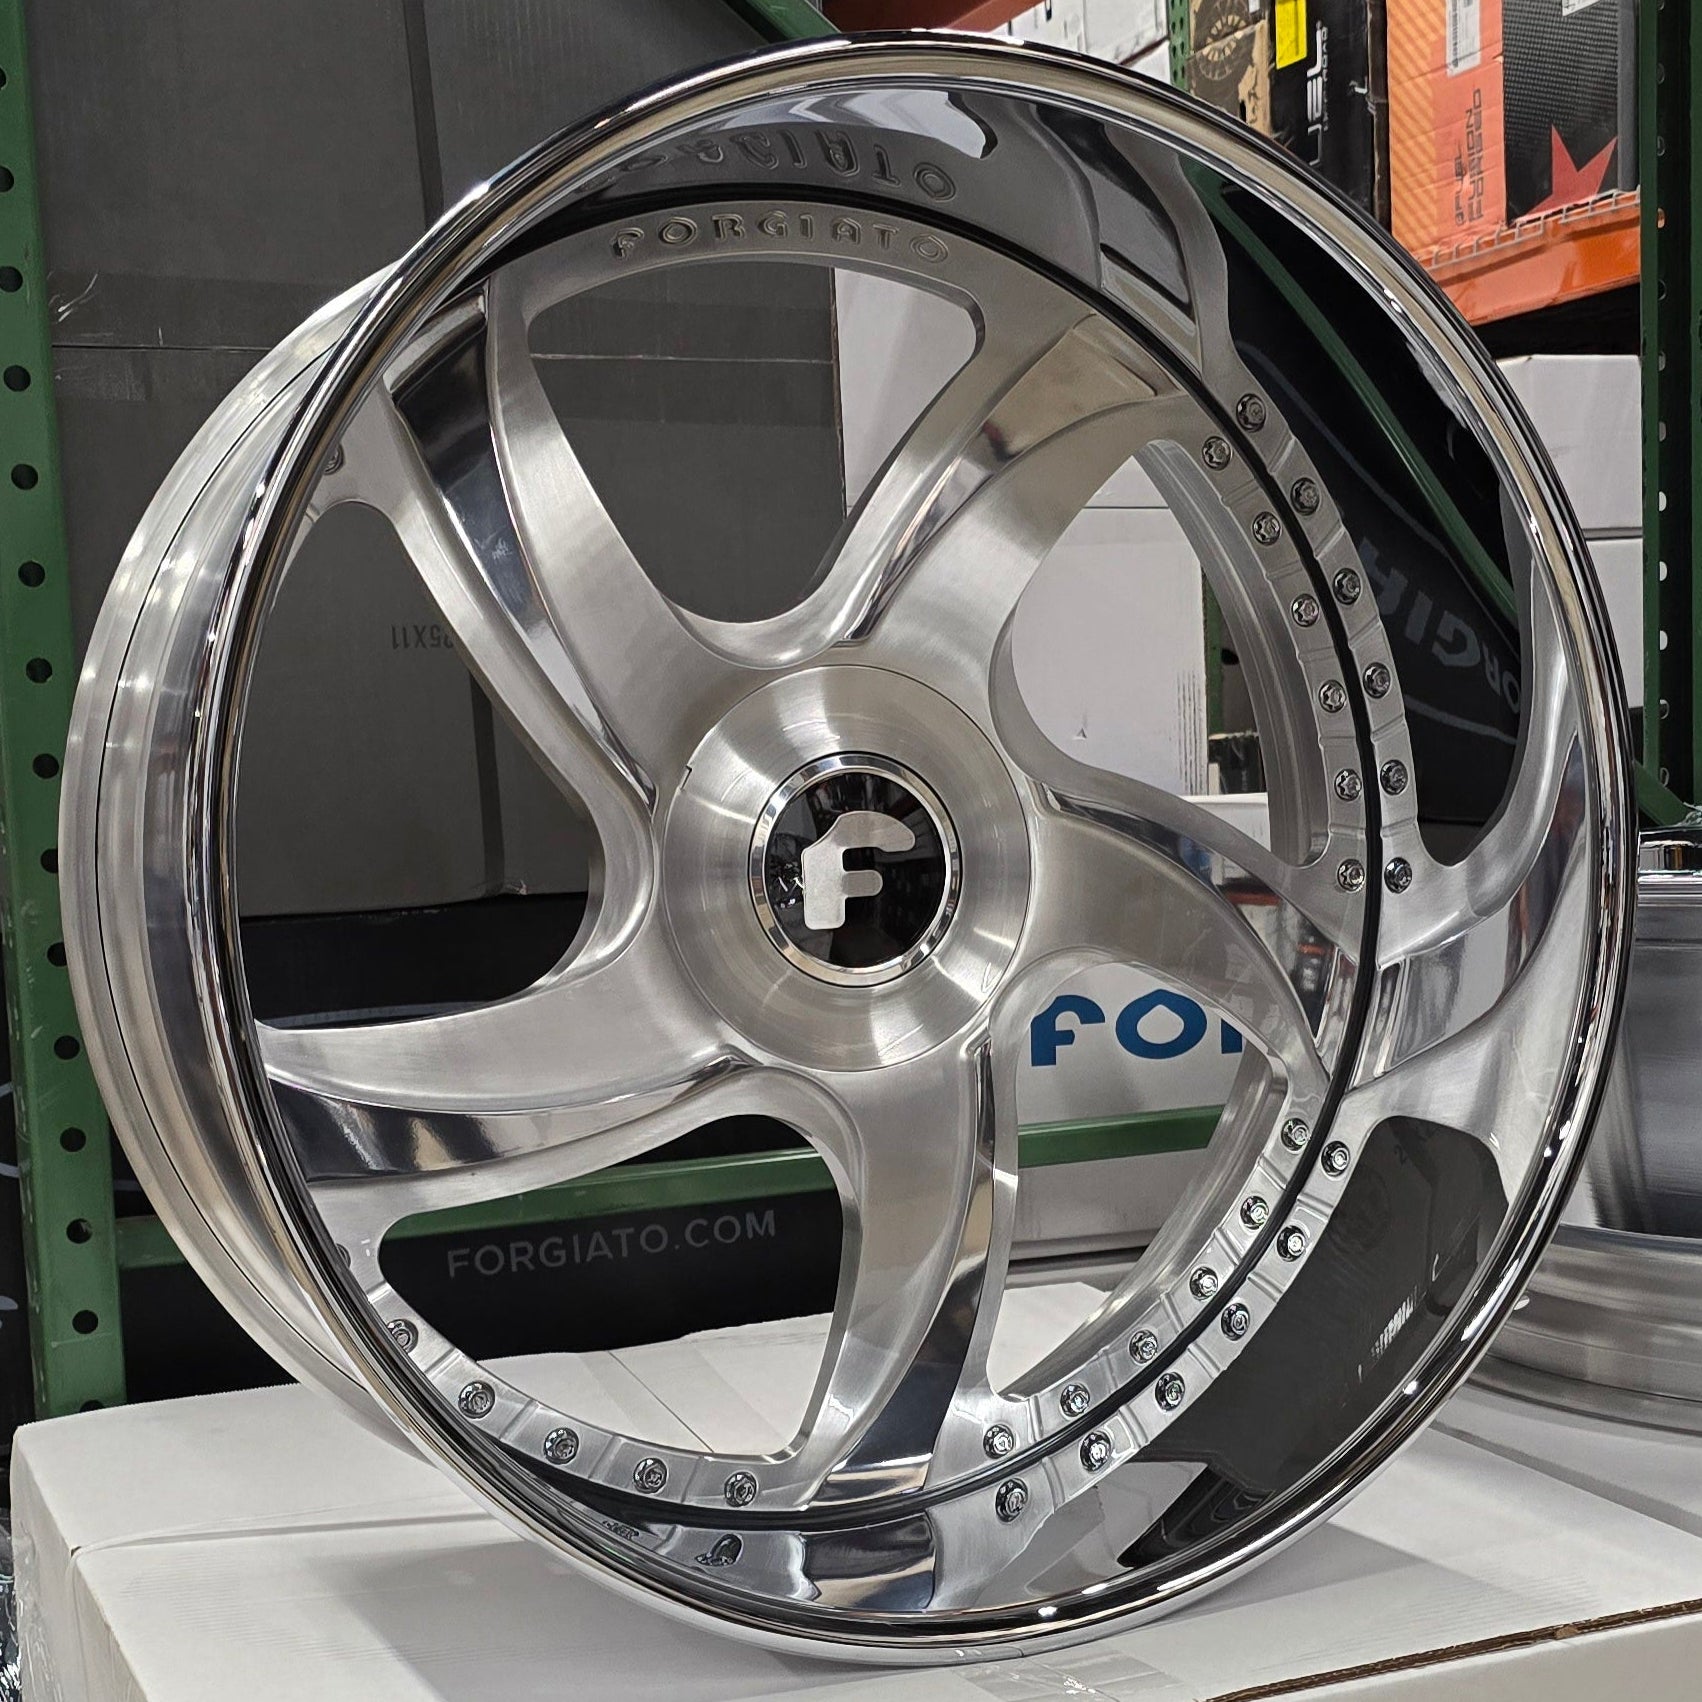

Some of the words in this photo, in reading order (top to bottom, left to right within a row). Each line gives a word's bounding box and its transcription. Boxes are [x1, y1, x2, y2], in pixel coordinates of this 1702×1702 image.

[1307, 28, 1322, 166] UEL
[610, 210, 949, 263] FORGIATO
[801, 811, 915, 930] F
[448, 1210, 775, 1278] FORGIATO.COM
